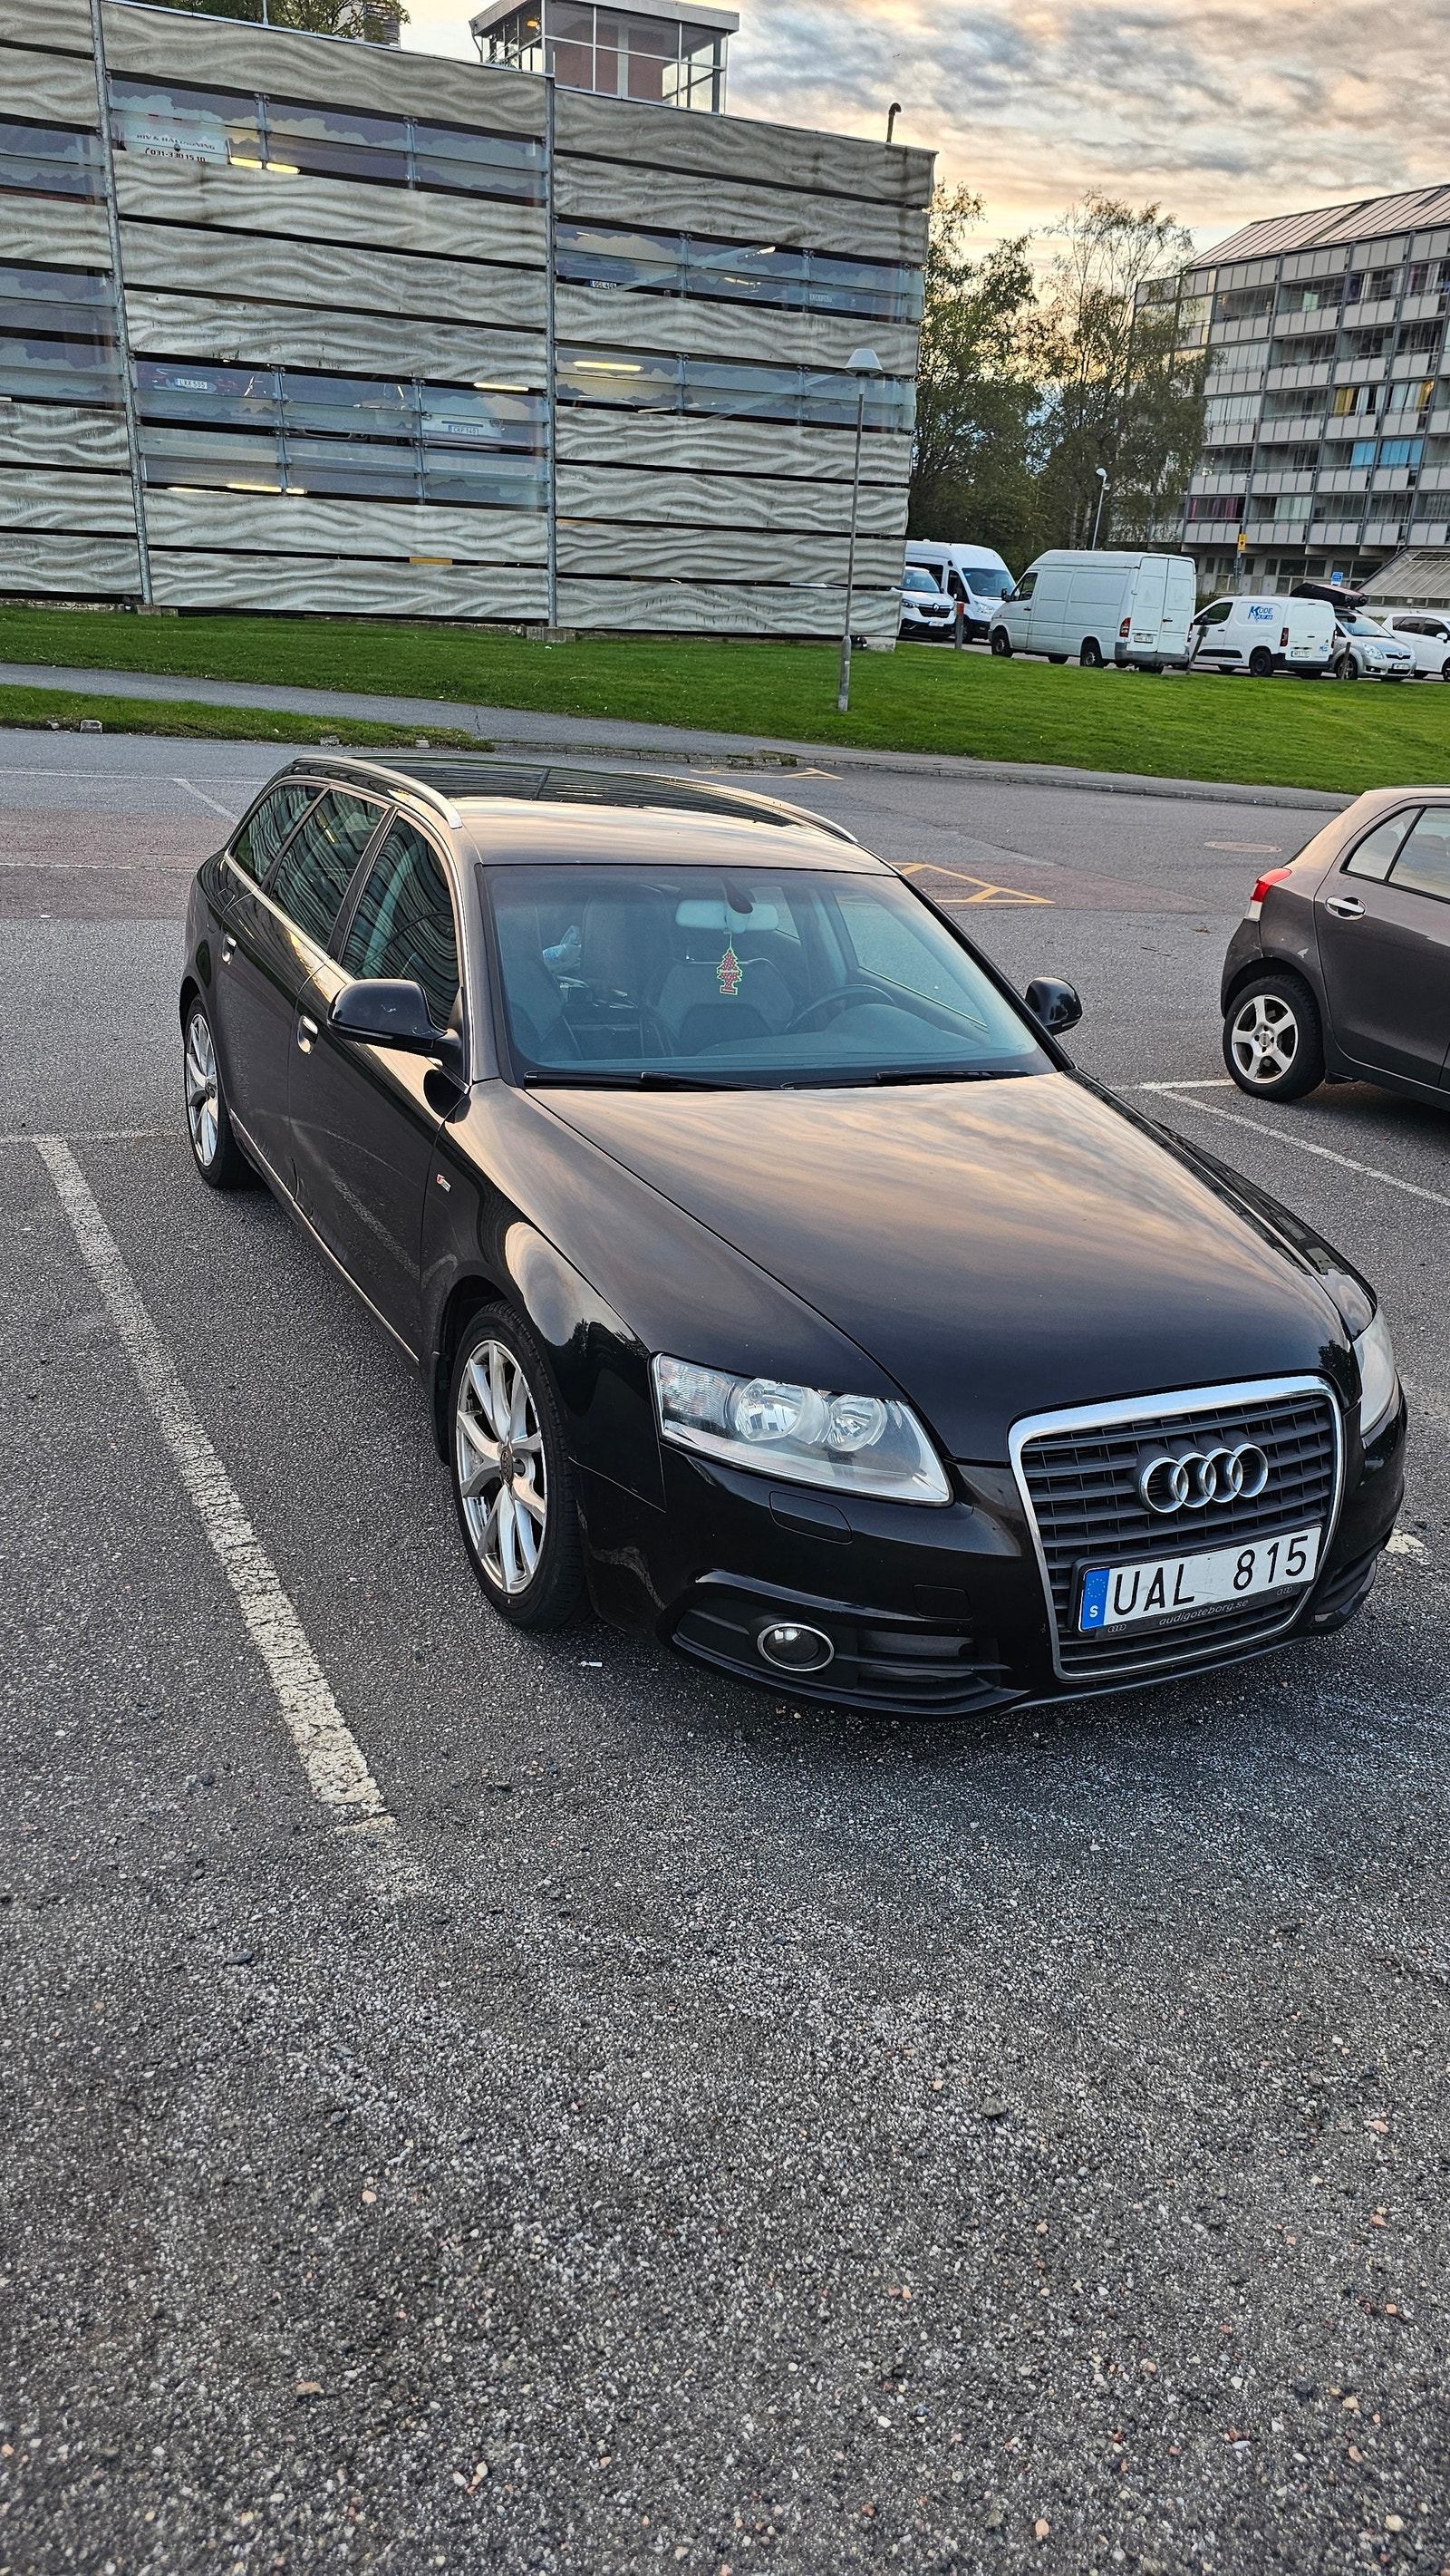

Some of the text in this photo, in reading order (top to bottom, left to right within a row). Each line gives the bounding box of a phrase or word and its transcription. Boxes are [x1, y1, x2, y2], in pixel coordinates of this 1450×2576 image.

[1113, 1535, 1309, 1616] UAL 815
[1089, 1604, 1098, 1618] S
[1158, 1599, 1249, 1625] audigoteborg.se
